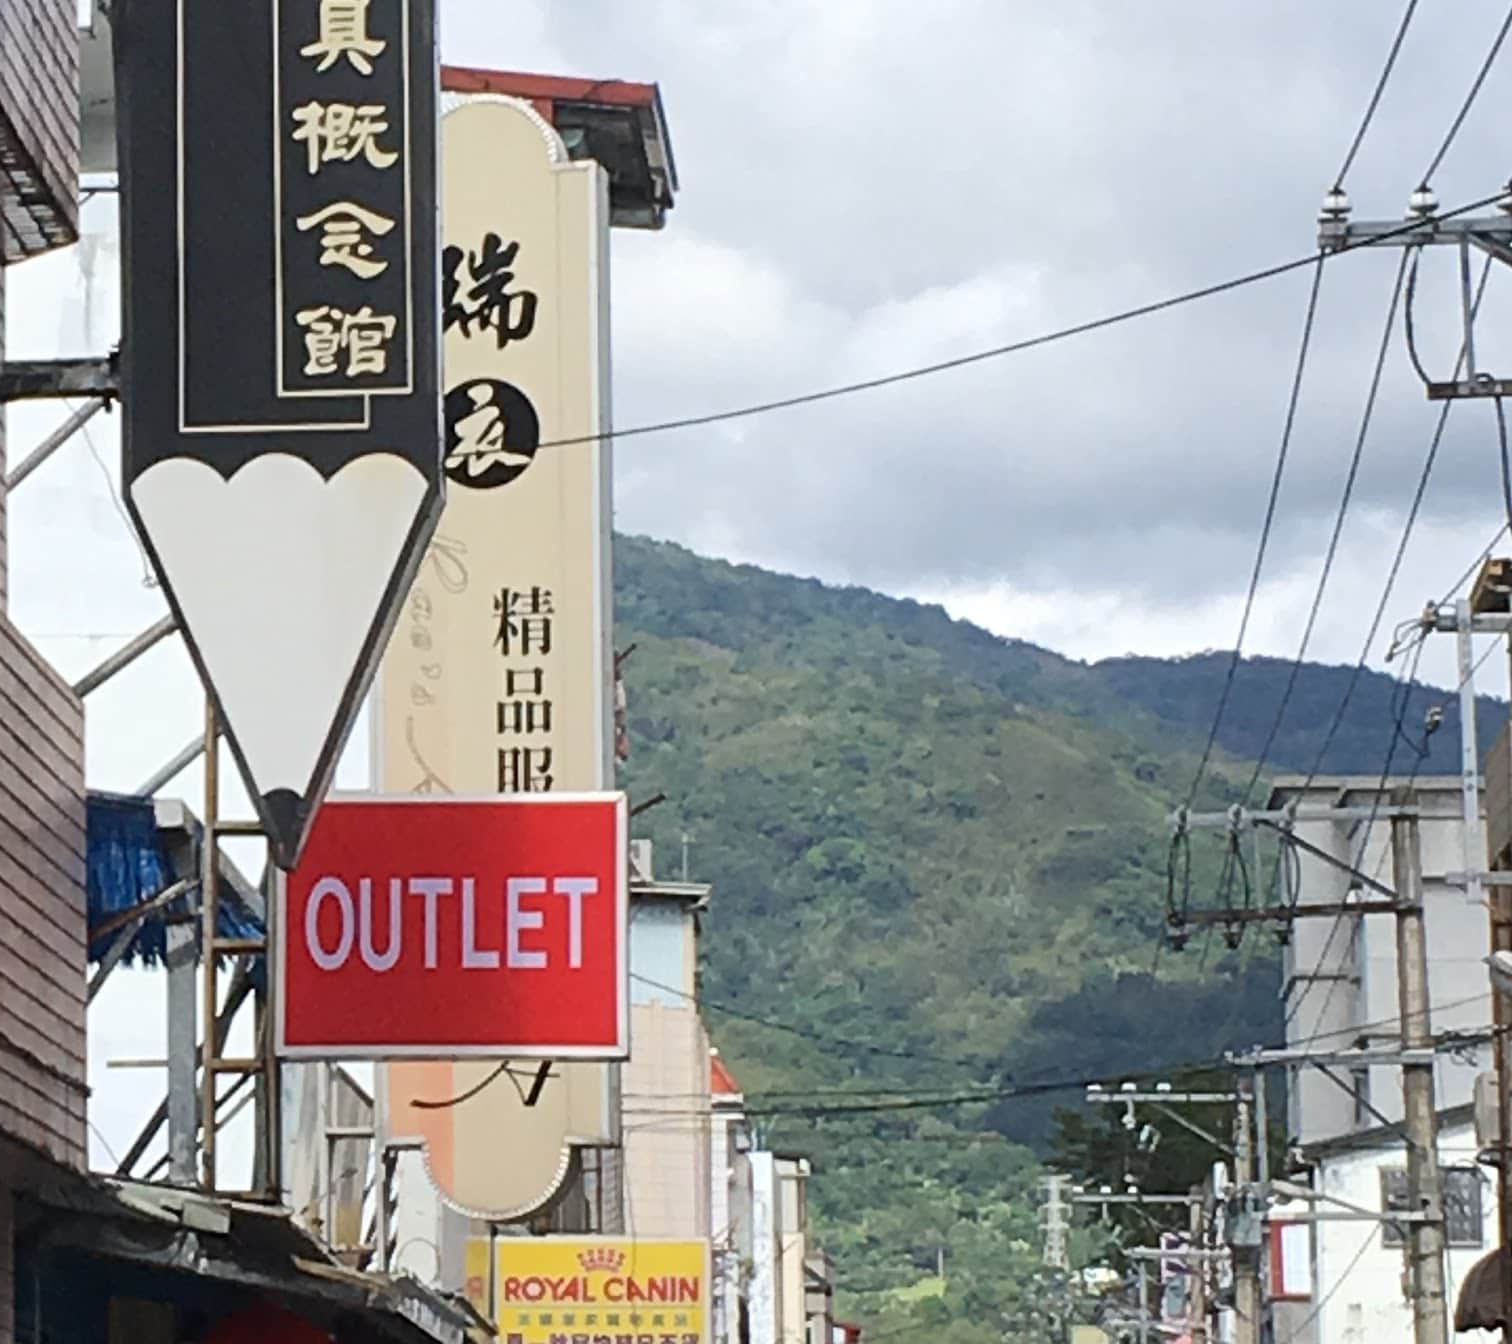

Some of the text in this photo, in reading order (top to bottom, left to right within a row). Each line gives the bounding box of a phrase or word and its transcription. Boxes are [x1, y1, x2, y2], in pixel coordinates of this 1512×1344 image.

[305, 876, 599, 972] OUTLET
[504, 1276, 597, 1302] ROYAL
[602, 1276, 700, 1302] CANIN
